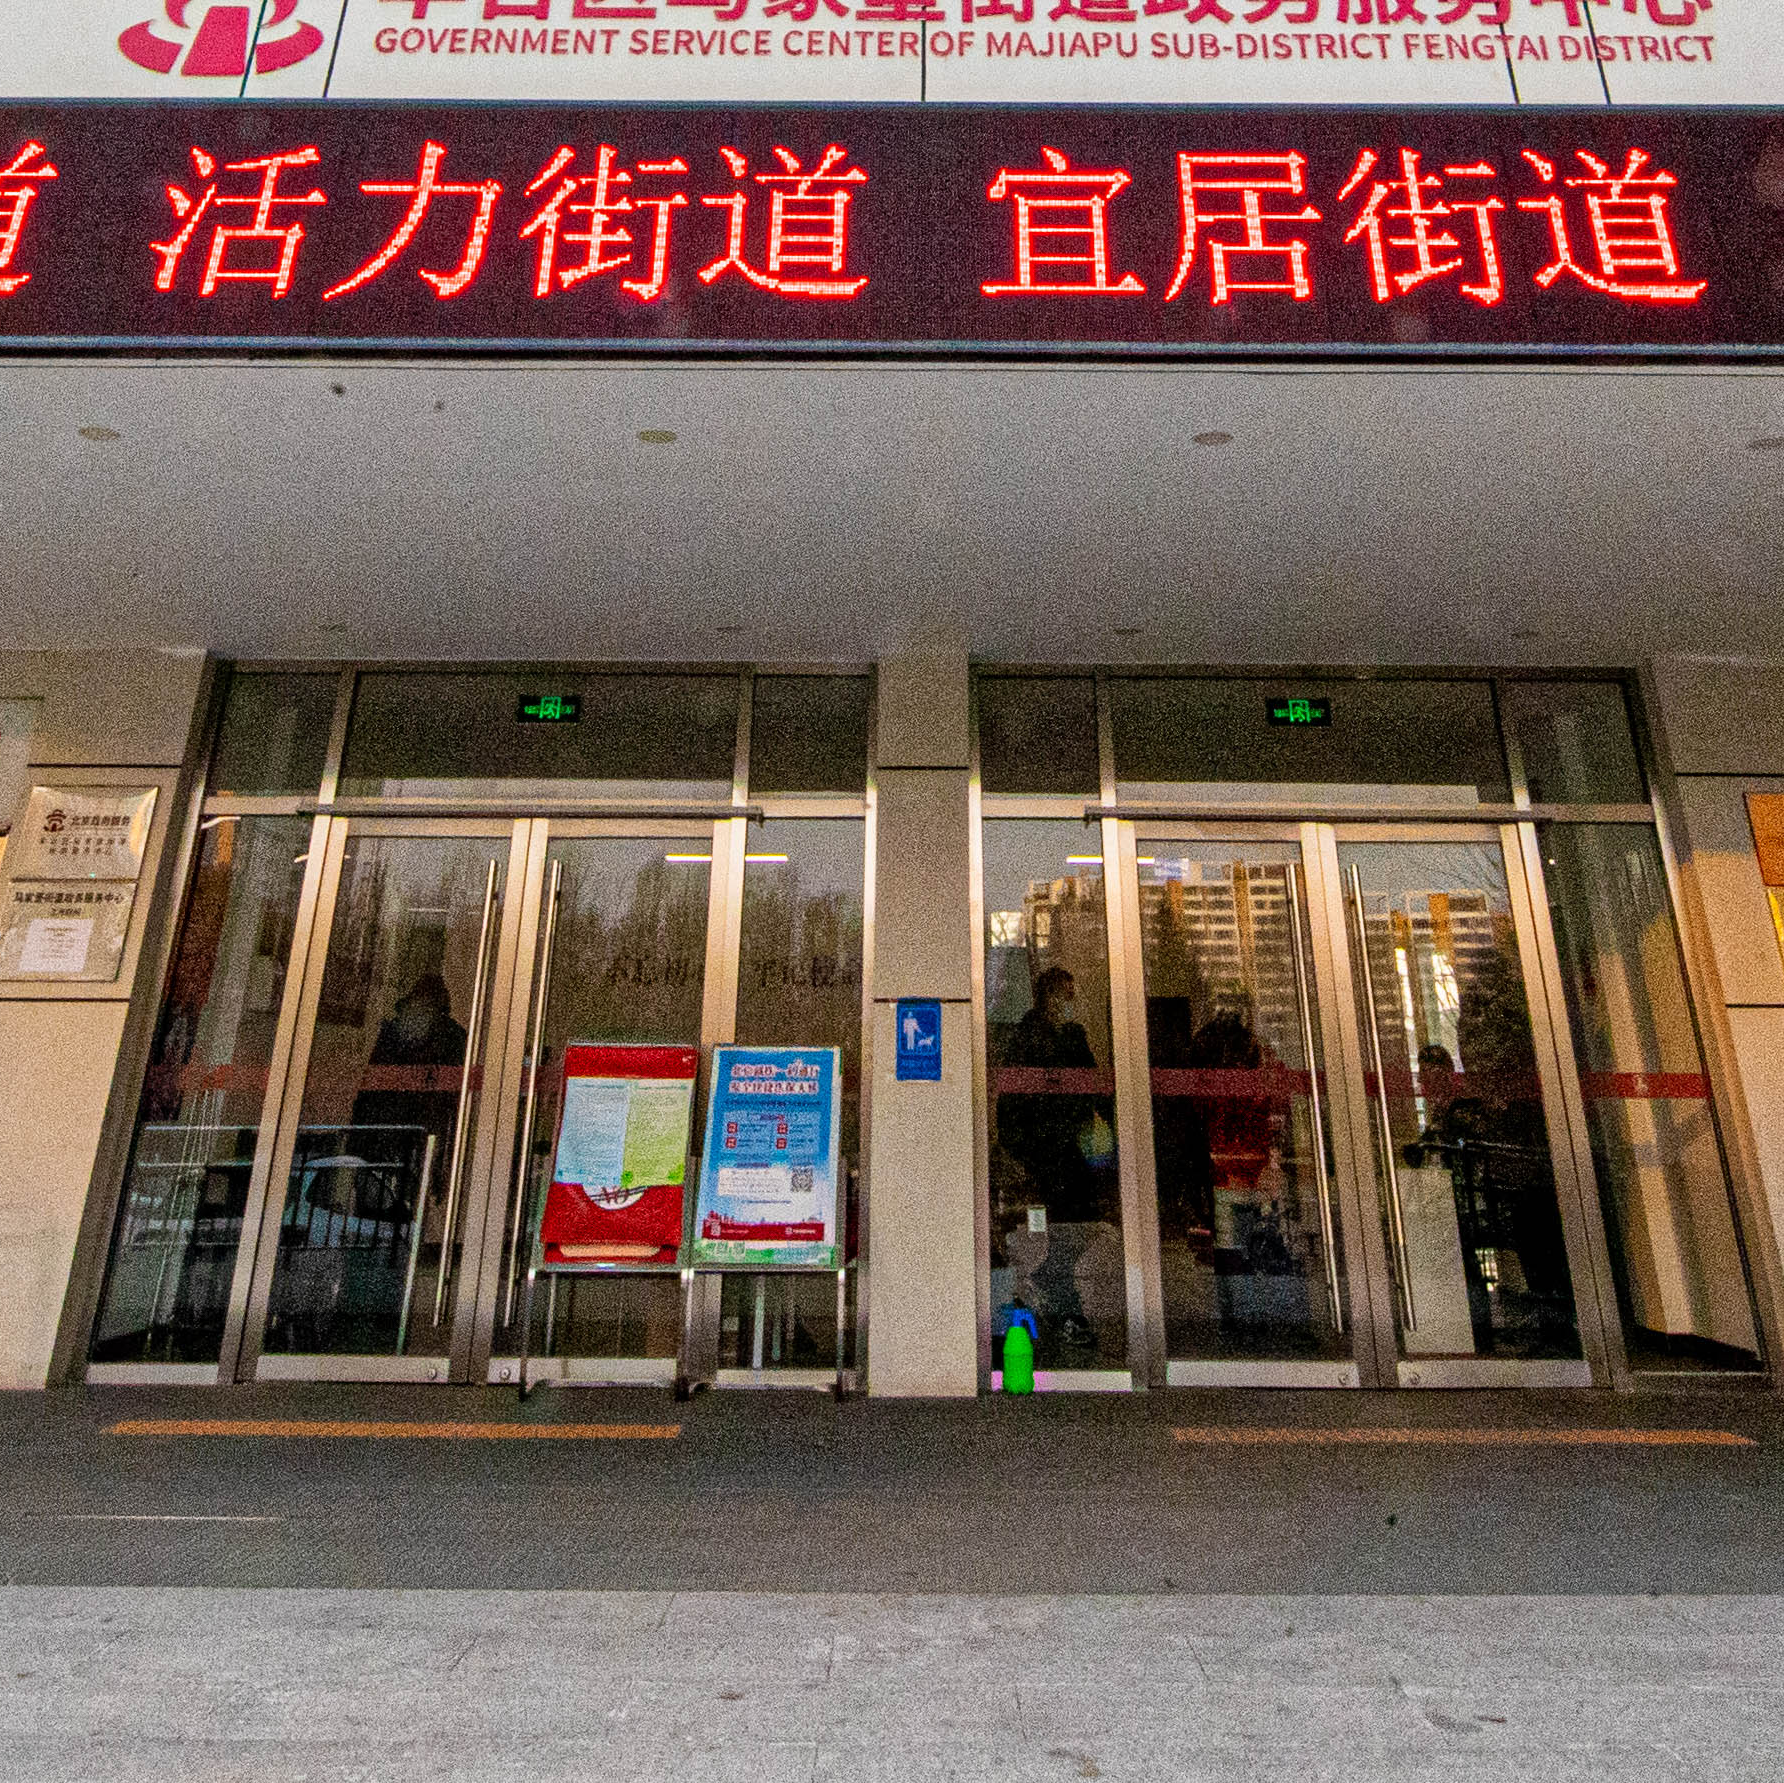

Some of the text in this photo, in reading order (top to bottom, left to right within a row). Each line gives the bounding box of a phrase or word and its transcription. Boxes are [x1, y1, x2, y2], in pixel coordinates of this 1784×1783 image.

[374, 27, 1713, 63] GOVERNMENT SERVICE CENTER OF MAJIAPU SUB-DISTRICT FENGTAI DISTRICT
[148, 138, 871, 306] 活力街道
[978, 144, 1709, 309] 宜居街道
